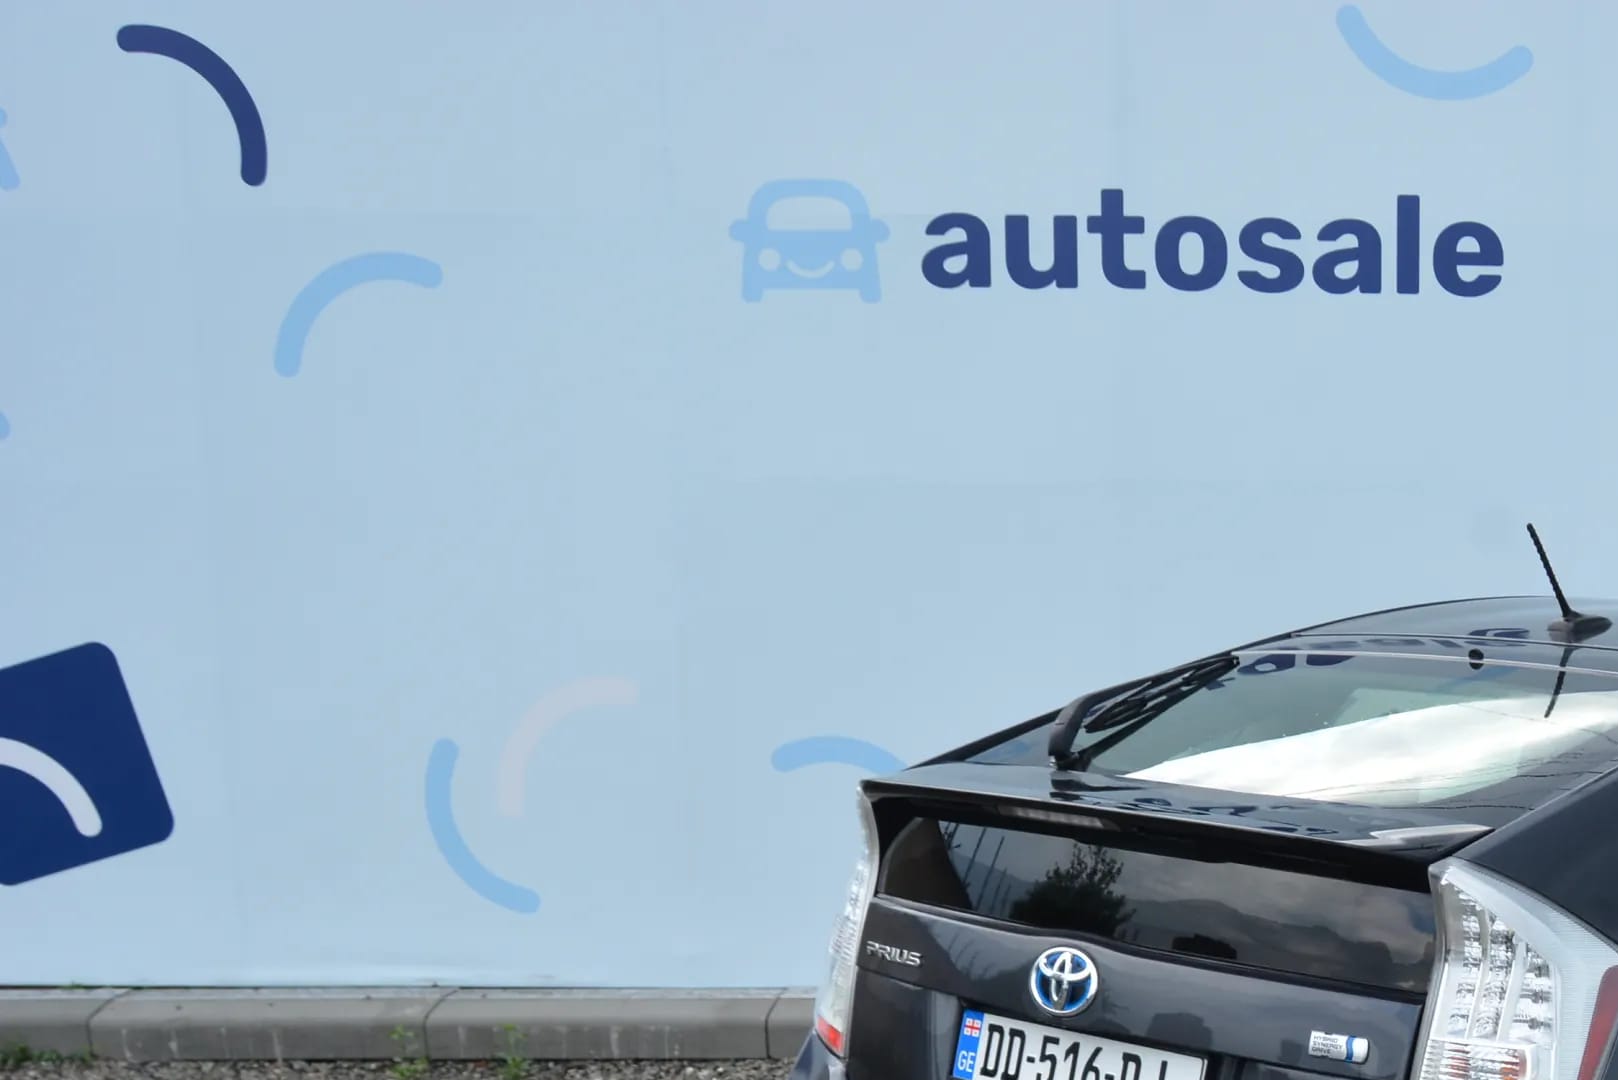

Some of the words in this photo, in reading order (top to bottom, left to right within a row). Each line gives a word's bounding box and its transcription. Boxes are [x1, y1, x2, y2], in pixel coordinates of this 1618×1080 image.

[920, 188, 1506, 298] autosale
[866, 940, 921, 967] PRIUS
[957, 1050, 975, 1073] GE
